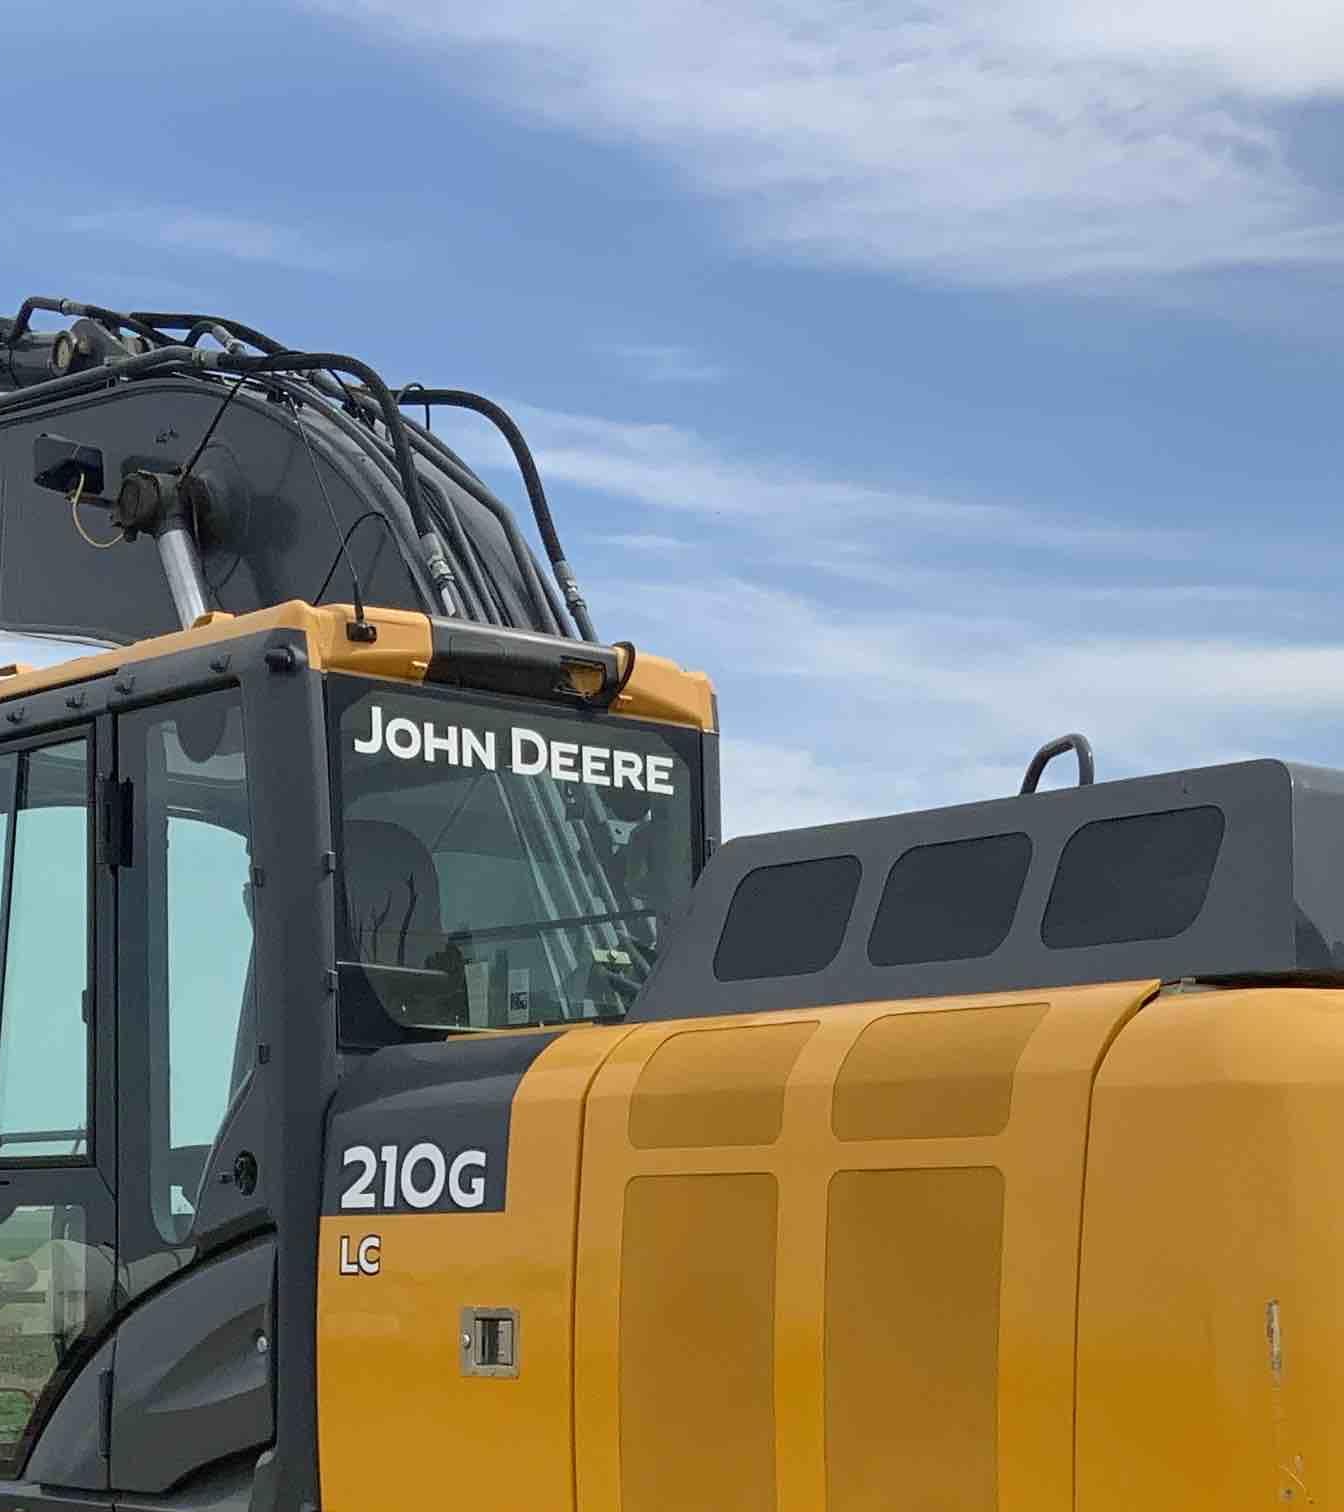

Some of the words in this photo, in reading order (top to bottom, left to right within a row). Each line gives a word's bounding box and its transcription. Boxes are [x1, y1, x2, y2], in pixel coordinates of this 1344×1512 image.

[354, 706, 496, 771] JOHN
[511, 727, 674, 796] DEERE
[341, 1142, 486, 1208] 210G
[340, 1235, 382, 1275] LC
